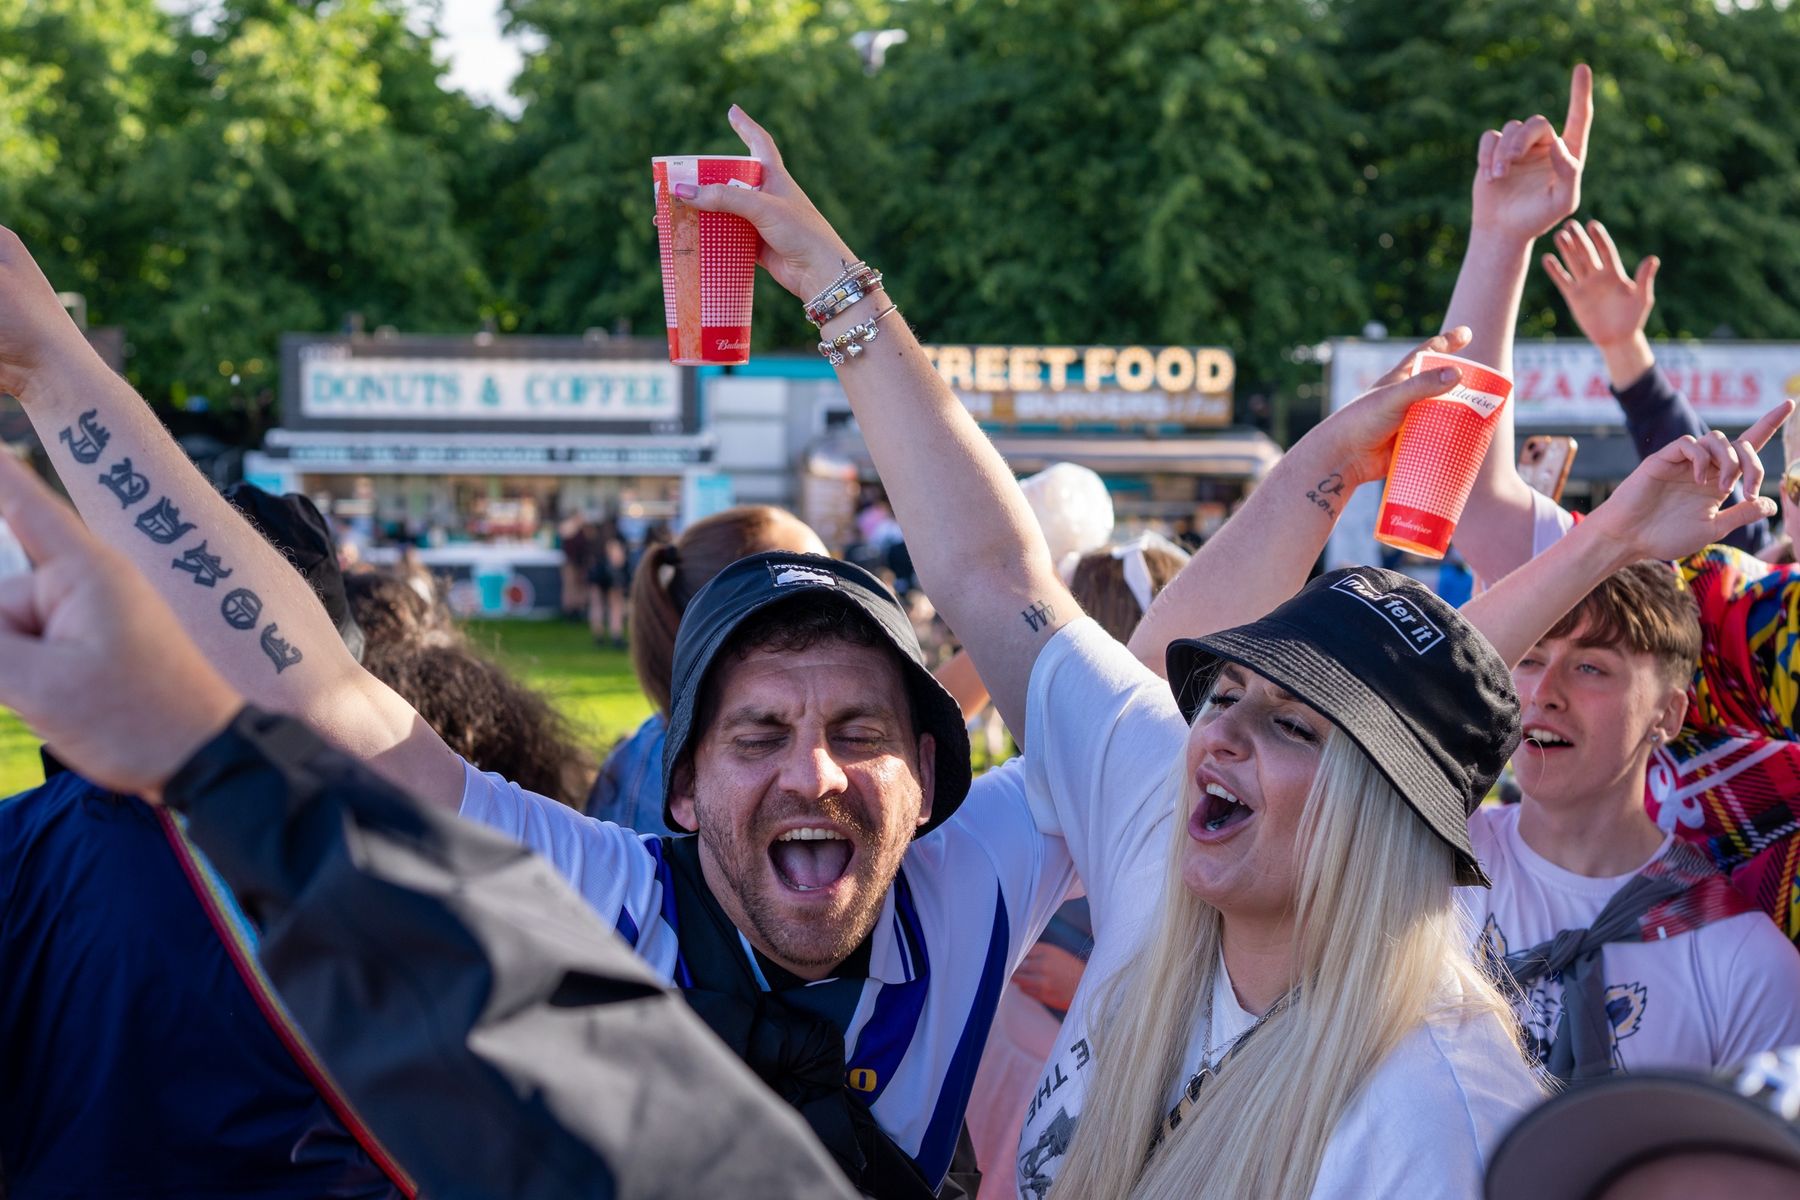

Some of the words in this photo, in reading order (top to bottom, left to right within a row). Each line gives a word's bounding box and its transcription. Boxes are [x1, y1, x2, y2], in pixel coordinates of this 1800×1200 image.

[312, 372, 461, 405] DONUTS
[479, 374, 502, 405] &
[524, 372, 667, 405] COFFEE
[922, 346, 1078, 391] REET
[1084, 345, 1235, 392] FOOD
[1389, 514, 1433, 536] Budweiser
[1383, 598, 1418, 624] fer
[1410, 624, 1434, 644] it
[1026, 1062, 1069, 1128] THE
